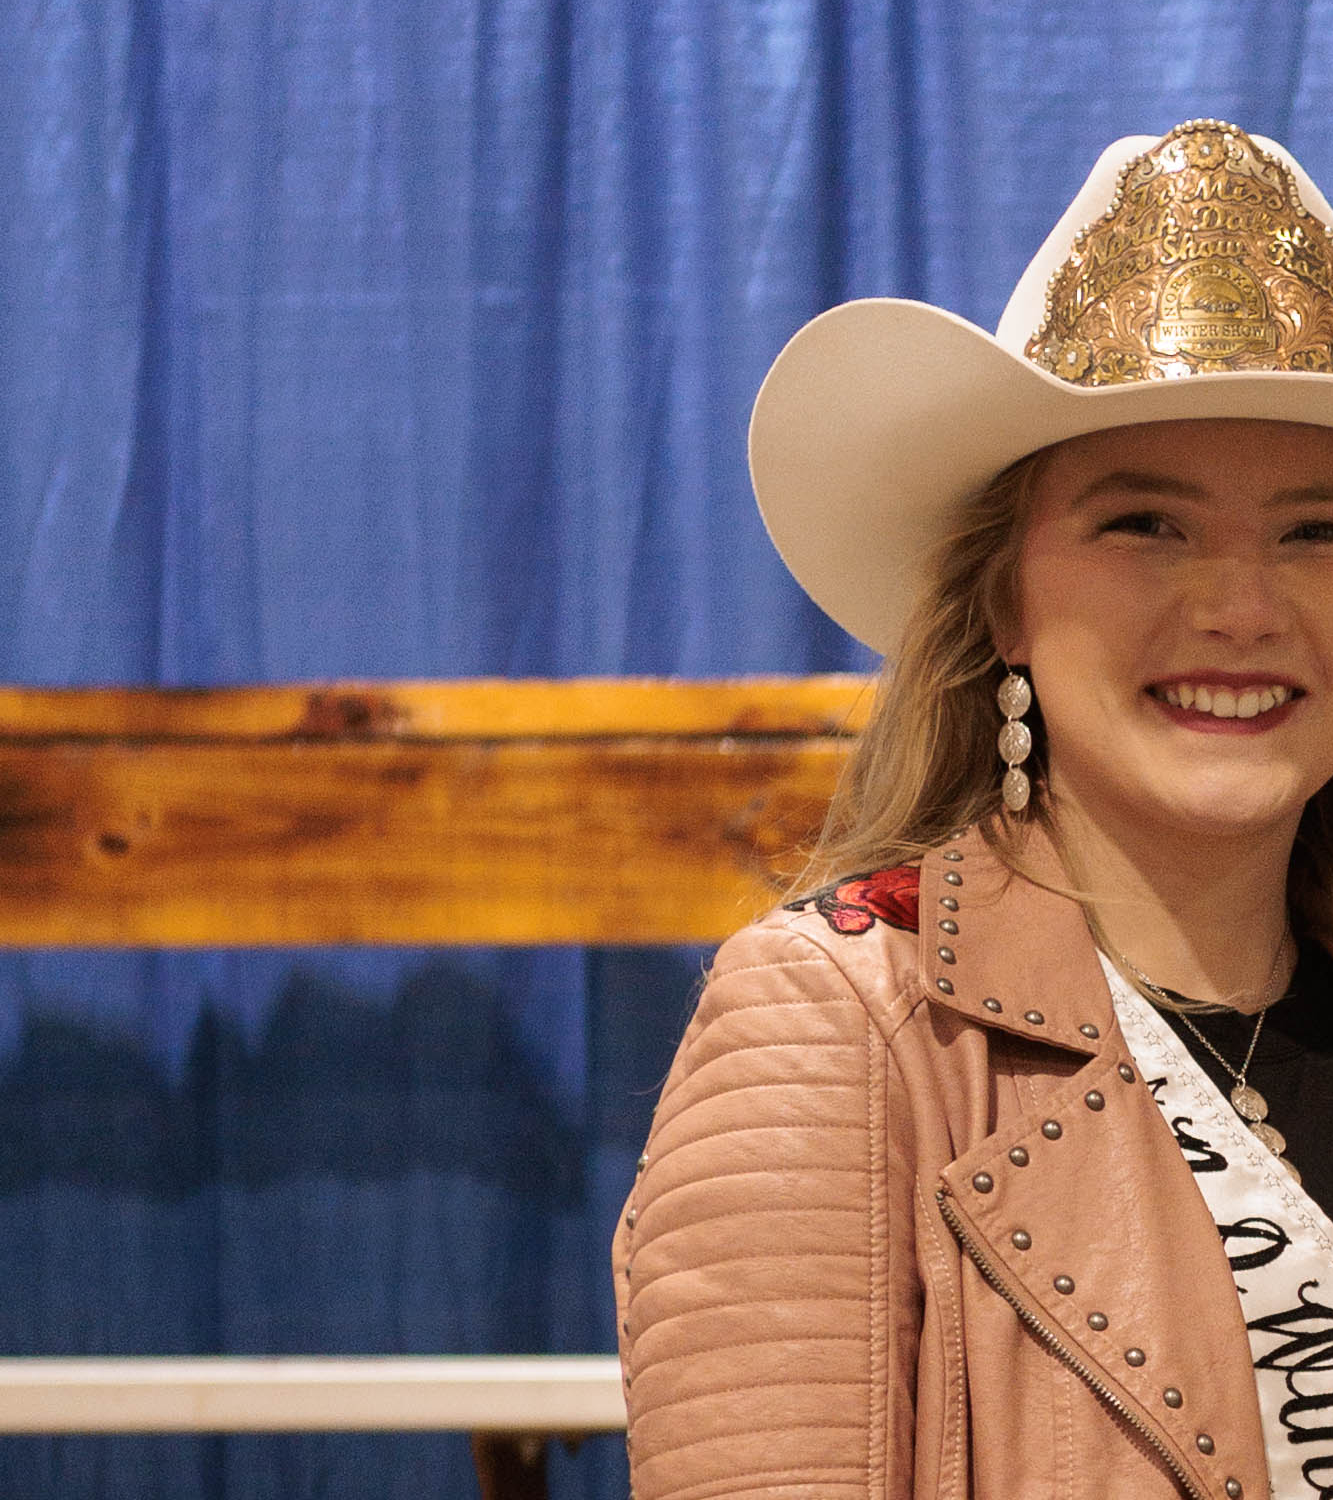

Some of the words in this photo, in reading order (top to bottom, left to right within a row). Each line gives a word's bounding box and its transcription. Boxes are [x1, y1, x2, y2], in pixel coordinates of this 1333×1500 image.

[1182, 174, 1284, 211] Miss
[1092, 208, 1180, 267] North
[1192, 204, 1323, 261] Dakota
[1159, 232, 1250, 265] Show
[1164, 265, 1202, 317] NORTH
[1210, 263, 1258, 317] DAKOTA
[1161, 324, 1219, 338] WINTER
[1222, 323, 1264, 338] SHOW
